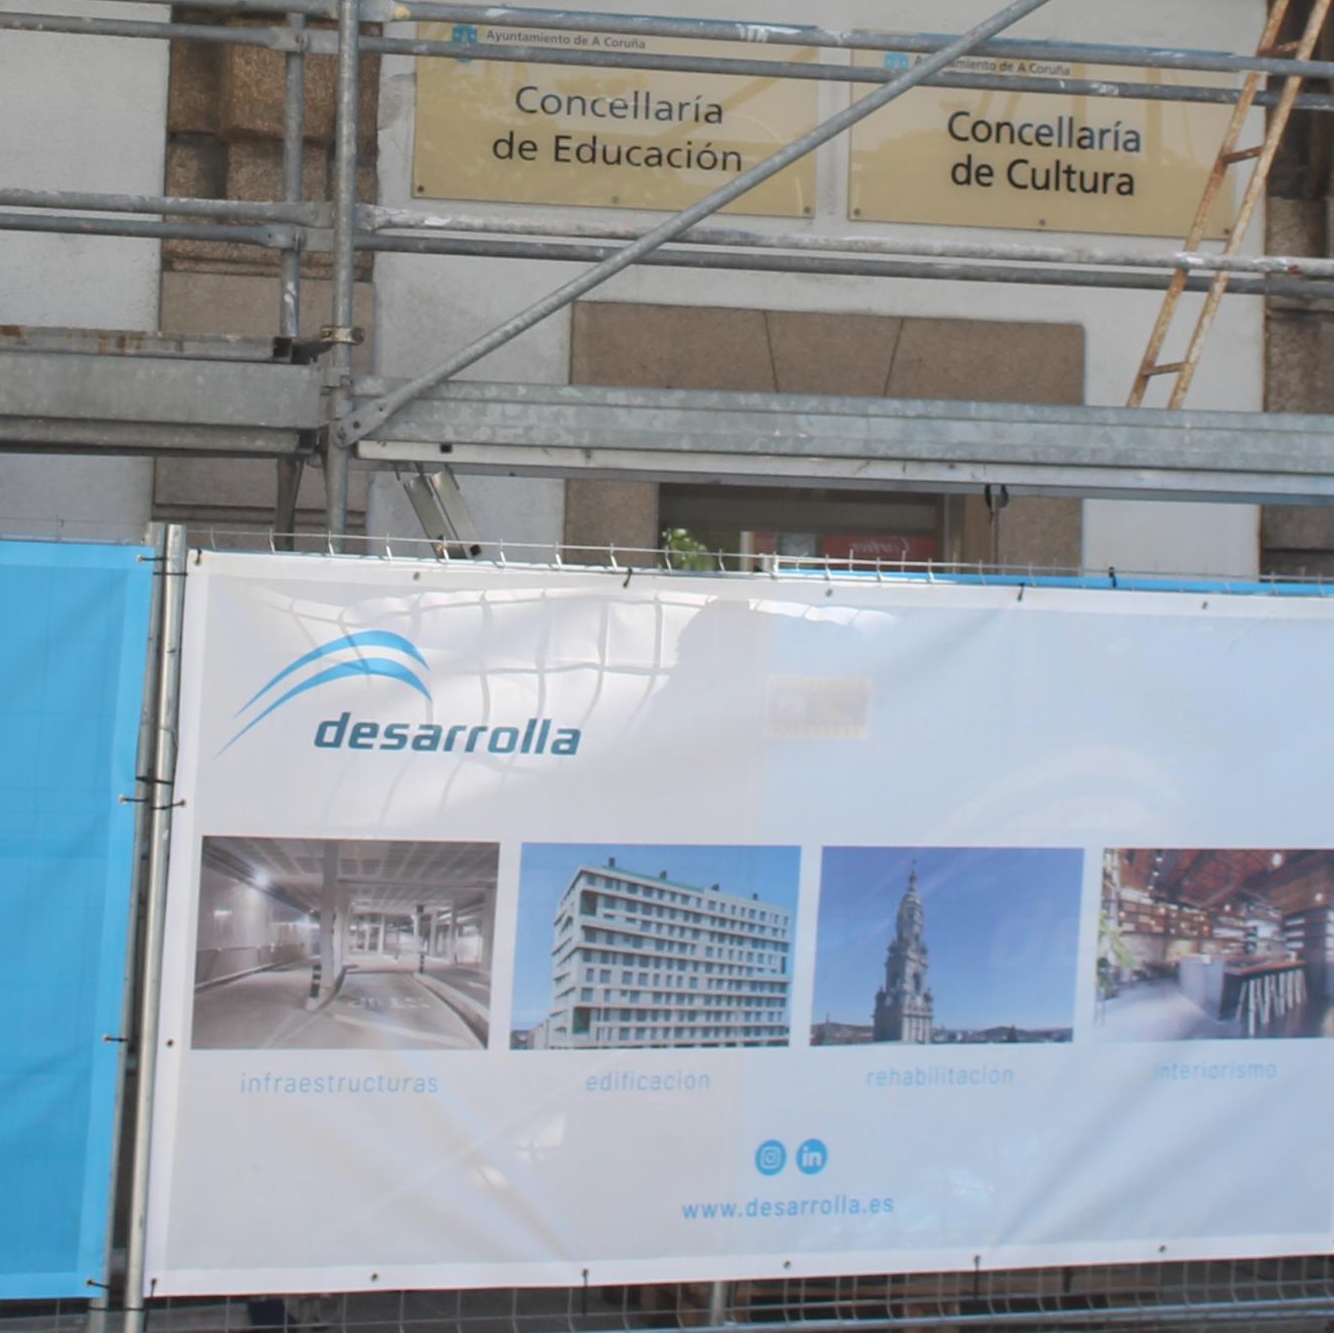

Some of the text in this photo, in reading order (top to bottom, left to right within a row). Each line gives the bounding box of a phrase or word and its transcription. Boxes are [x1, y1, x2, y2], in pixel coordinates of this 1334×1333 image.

[485, 29, 647, 50] Ayuntamiento de A Coruña
[1017, 61, 1027, 73] A
[515, 86, 724, 124] Concellaría
[947, 111, 1142, 153] Concellaría
[492, 131, 743, 172] de Educación
[951, 153, 1135, 196] de Cultura
[313, 711, 582, 755] desarrolla
[239, 1071, 440, 1094] infraestructuras
[681, 1194, 895, 1219] www.desarrolla.es
